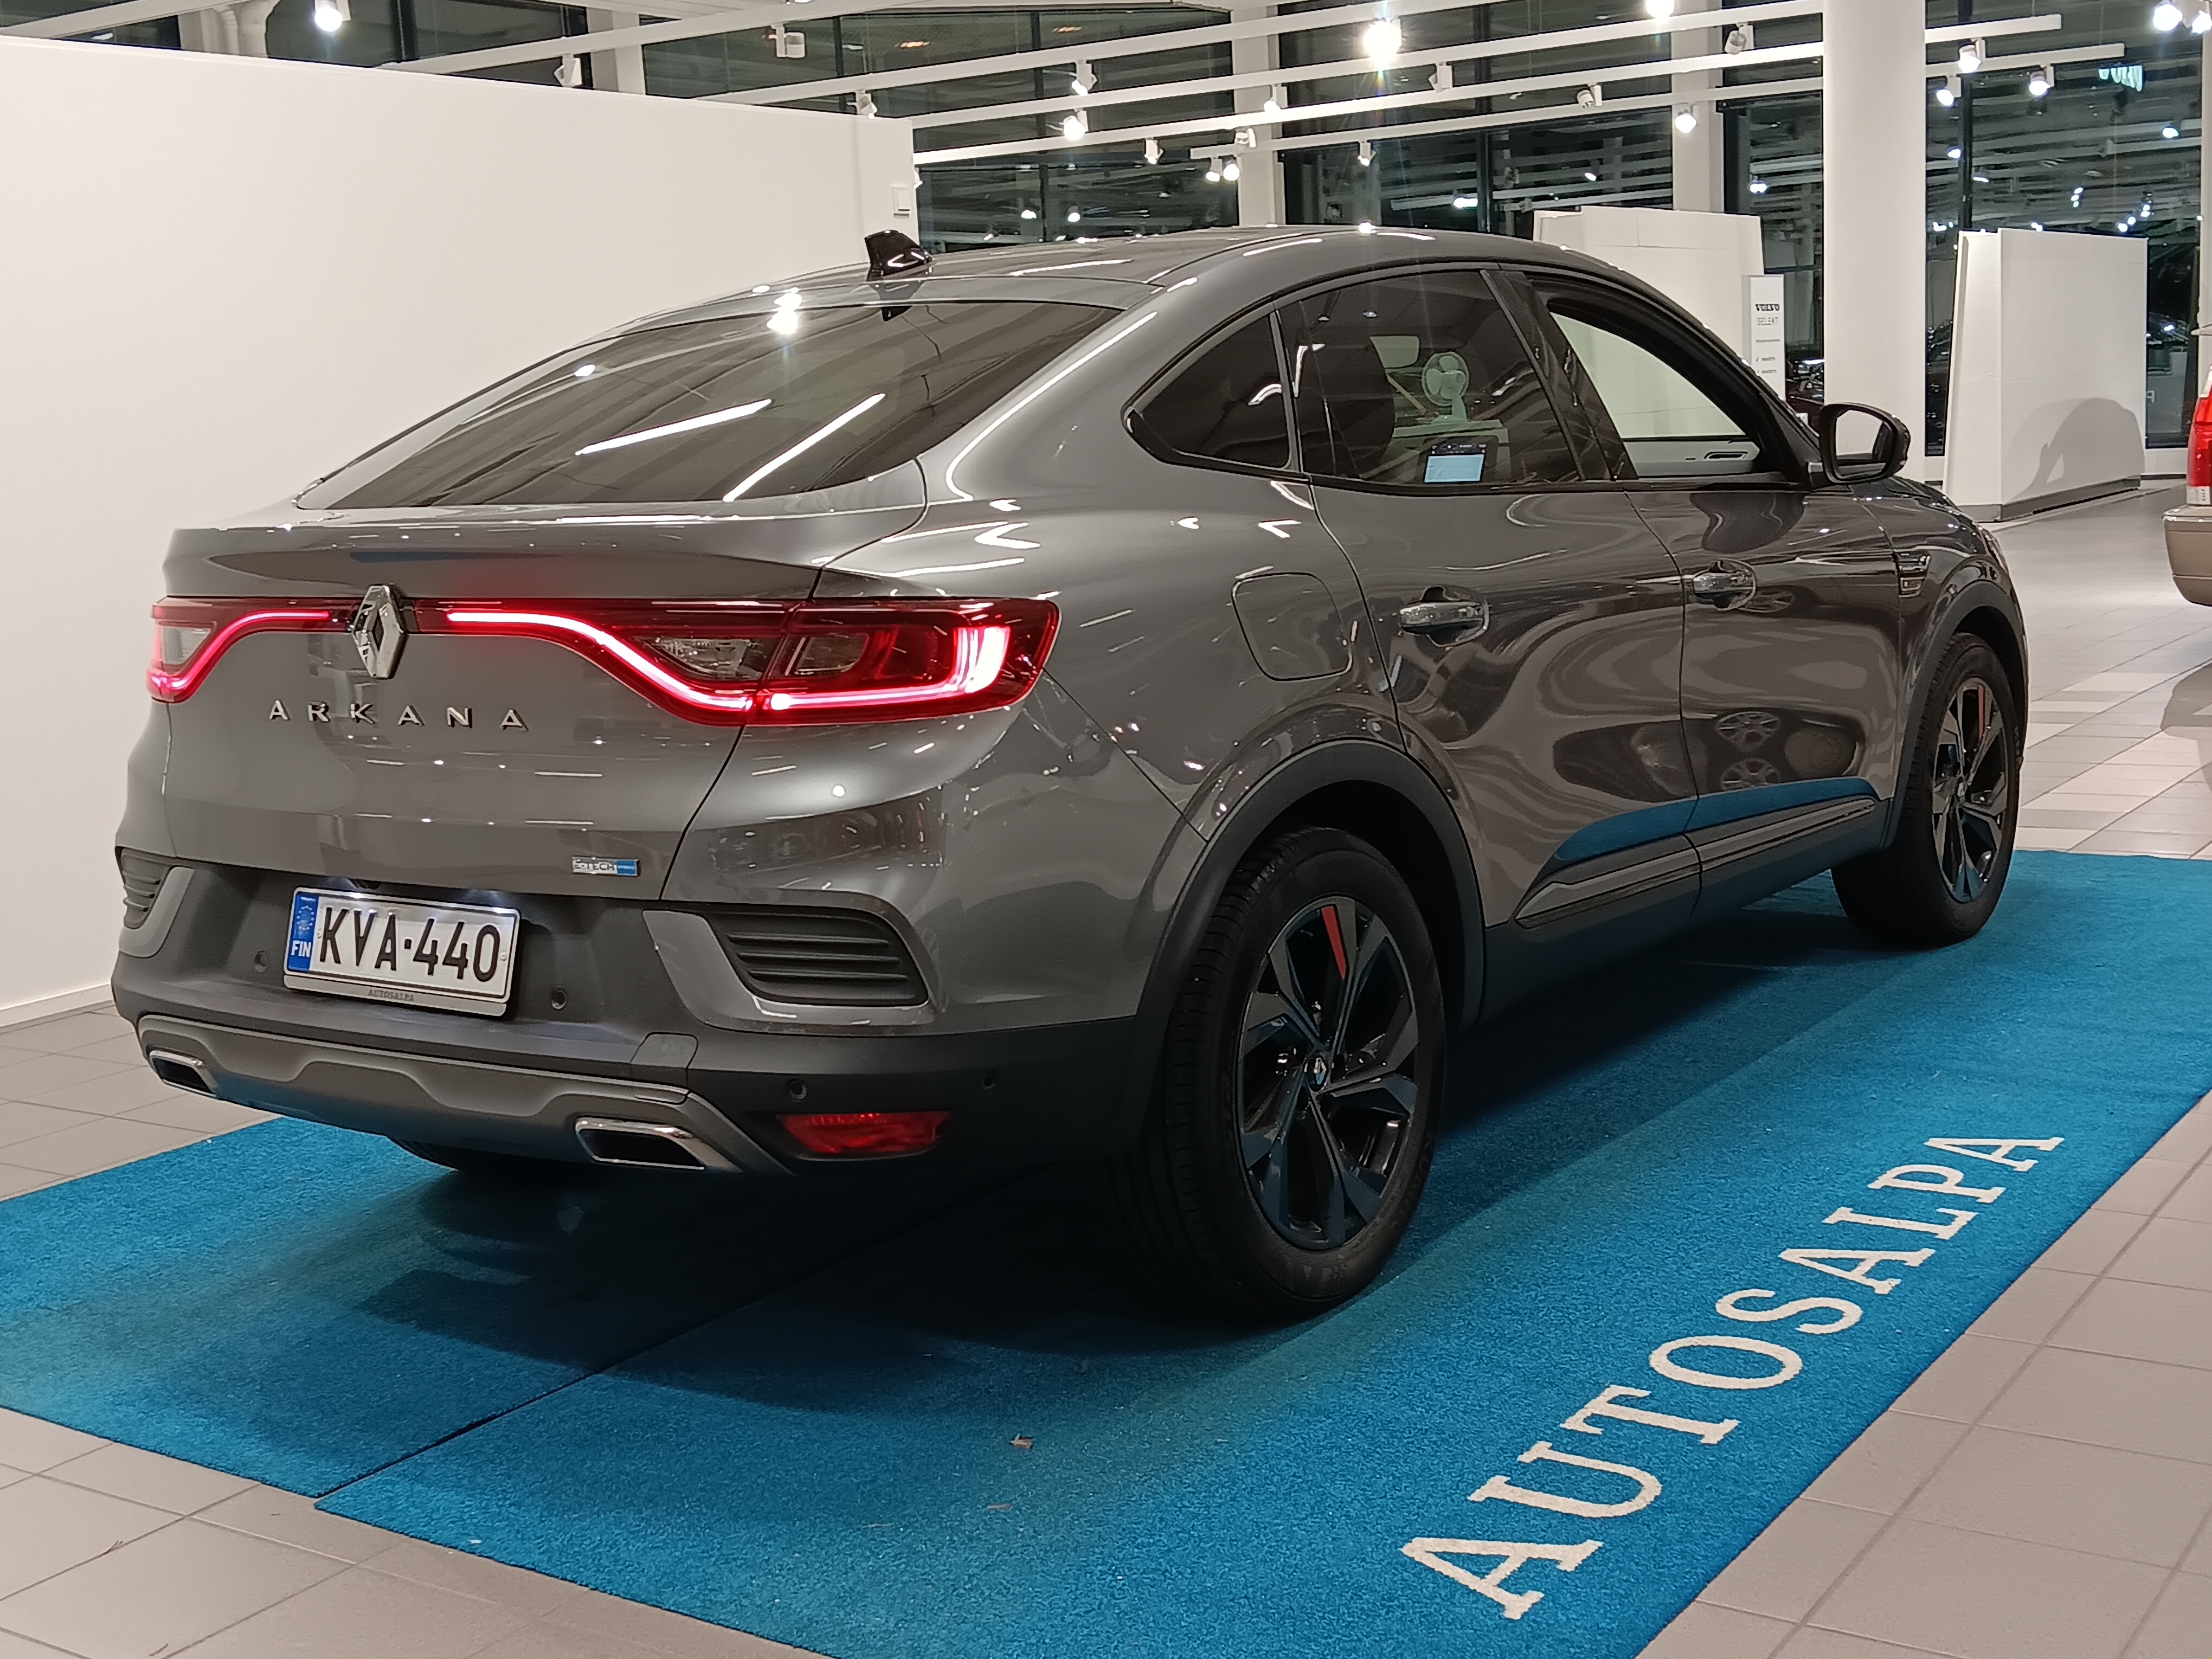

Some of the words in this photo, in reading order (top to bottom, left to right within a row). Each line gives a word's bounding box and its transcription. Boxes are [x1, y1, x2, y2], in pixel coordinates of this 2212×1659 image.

[269, 699, 528, 730] ARKANA
[291, 940, 311, 957] FIN
[319, 906, 500, 982] KVA-440
[1400, 1137, 2065, 1619] AUTOSALPA
